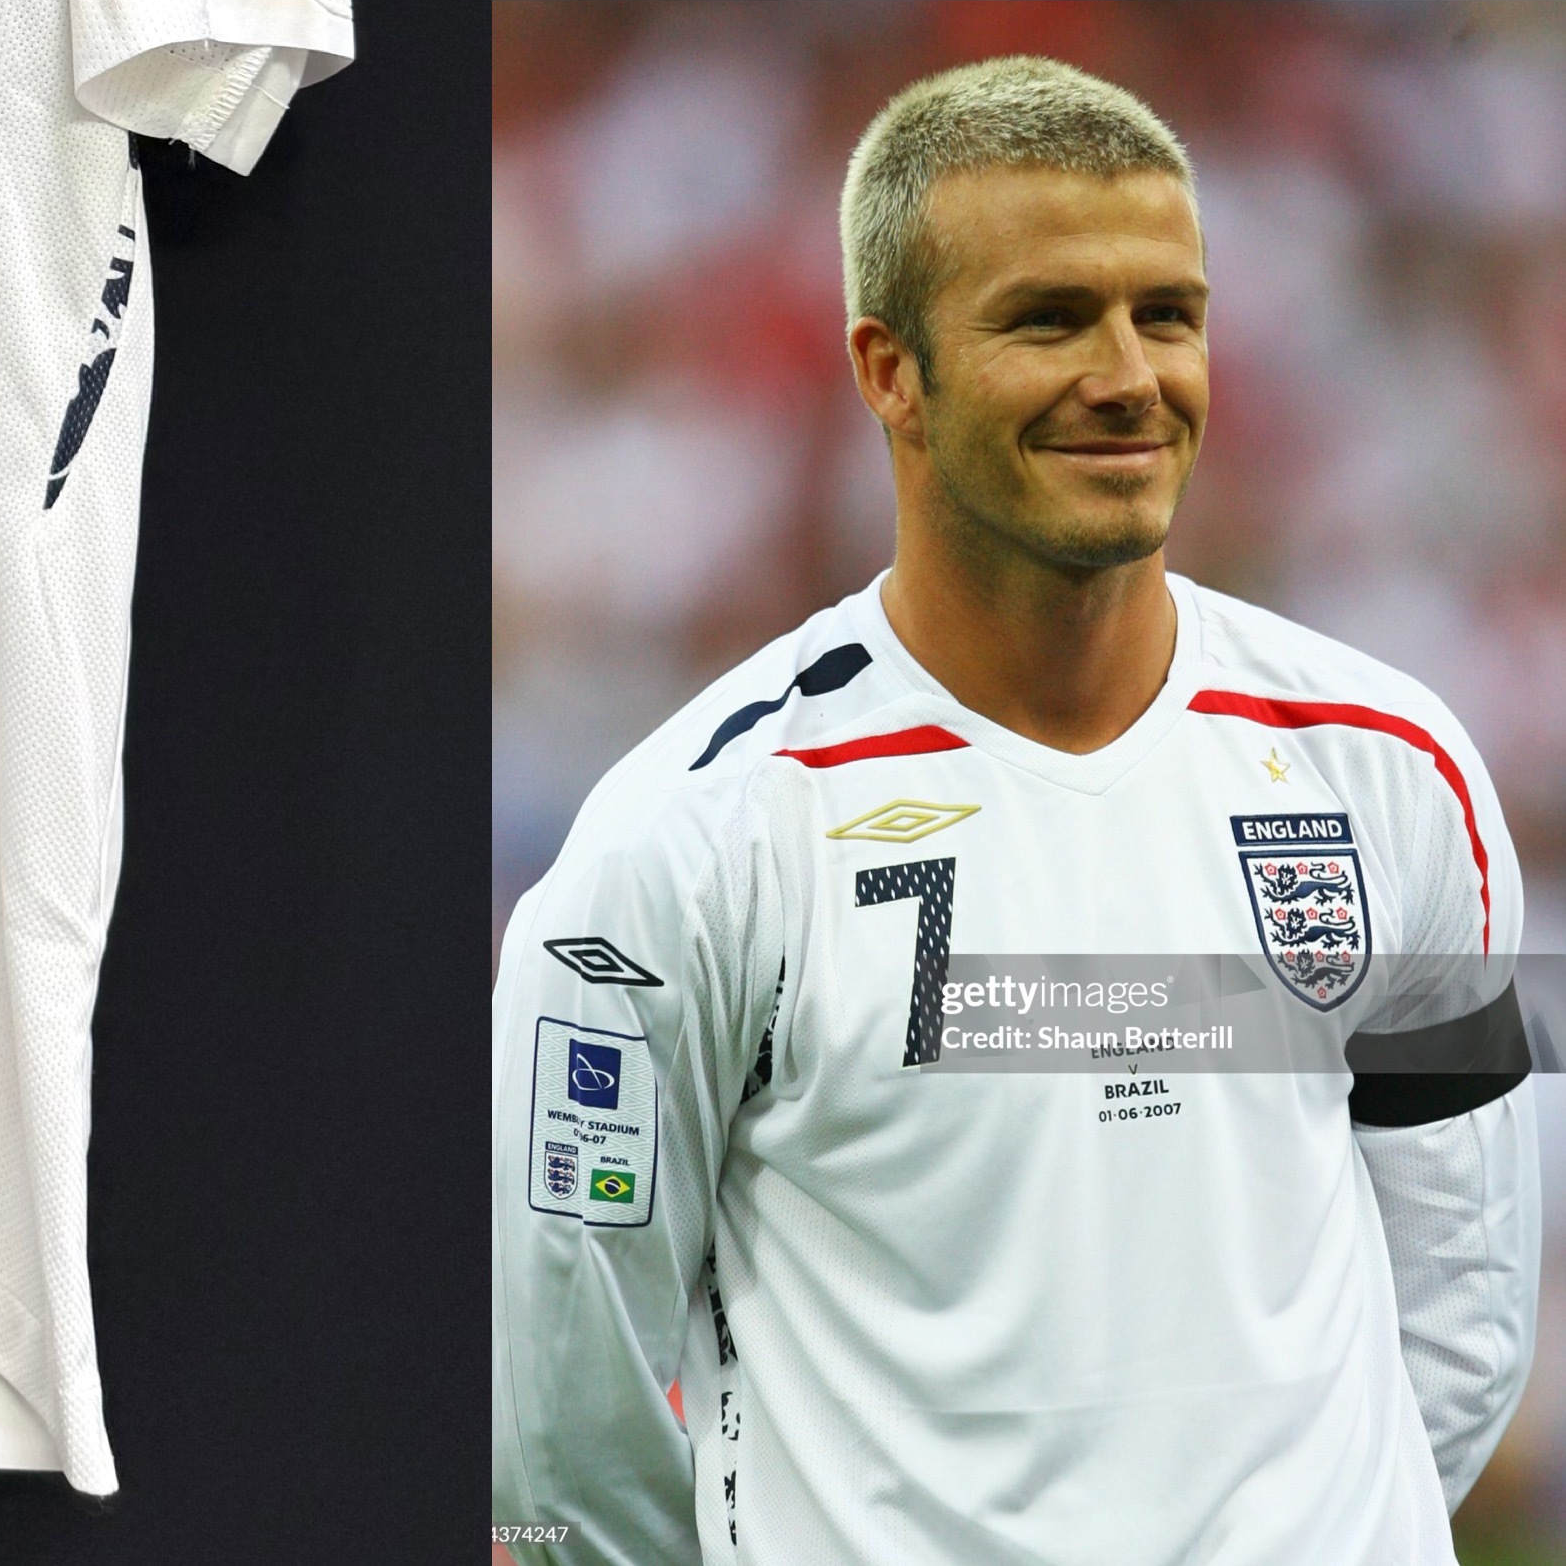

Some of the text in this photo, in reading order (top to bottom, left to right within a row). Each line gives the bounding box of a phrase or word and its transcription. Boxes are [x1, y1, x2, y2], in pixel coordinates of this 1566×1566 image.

[1242, 819, 1343, 841] ENGLAND
[855, 857, 956, 1068] 7
[1104, 1079, 1170, 1100] BRAZIL
[587, 1121, 640, 1136] STADIUM
[547, 1143, 577, 1154] ENGLAND
[600, 1156, 631, 1166] BRAZIL
